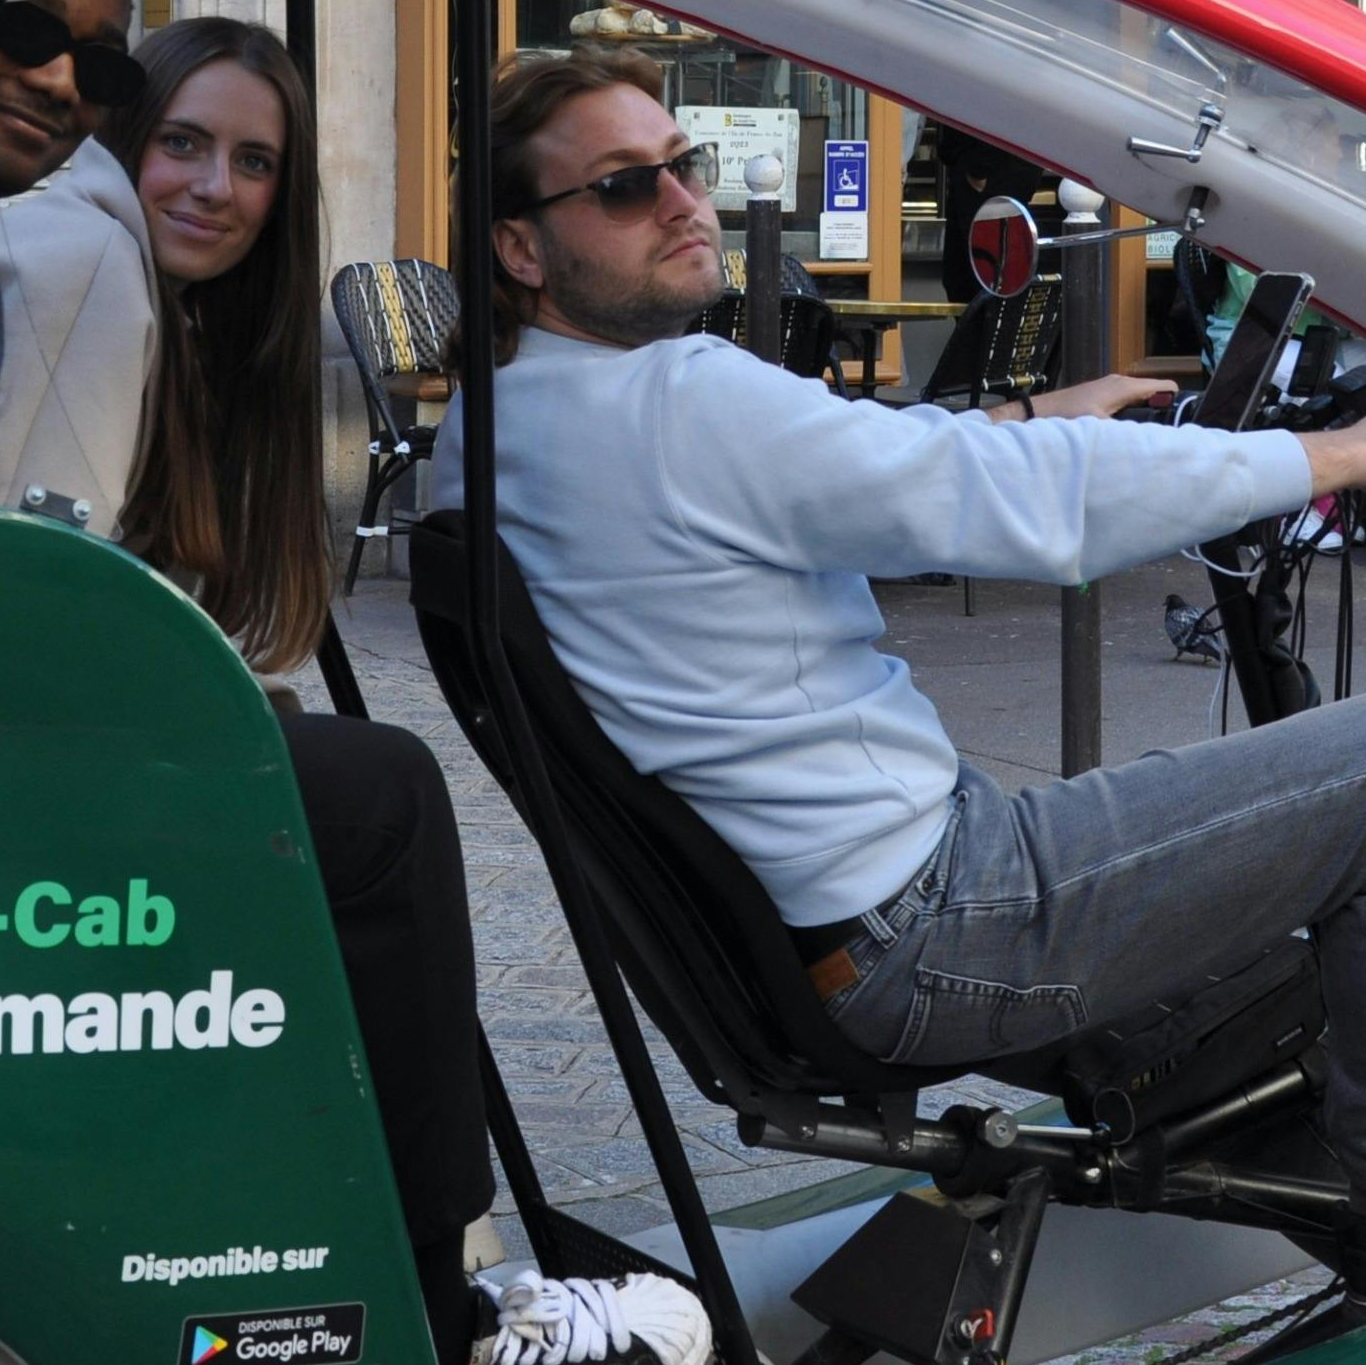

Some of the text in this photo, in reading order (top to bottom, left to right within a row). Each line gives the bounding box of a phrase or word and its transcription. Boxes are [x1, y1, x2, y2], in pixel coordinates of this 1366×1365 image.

[121, 1243, 329, 1286] Disponible sur
[238, 1314, 326, 1334] DISPONIBLE SUR
[235, 1330, 353, 1362] Google Play
